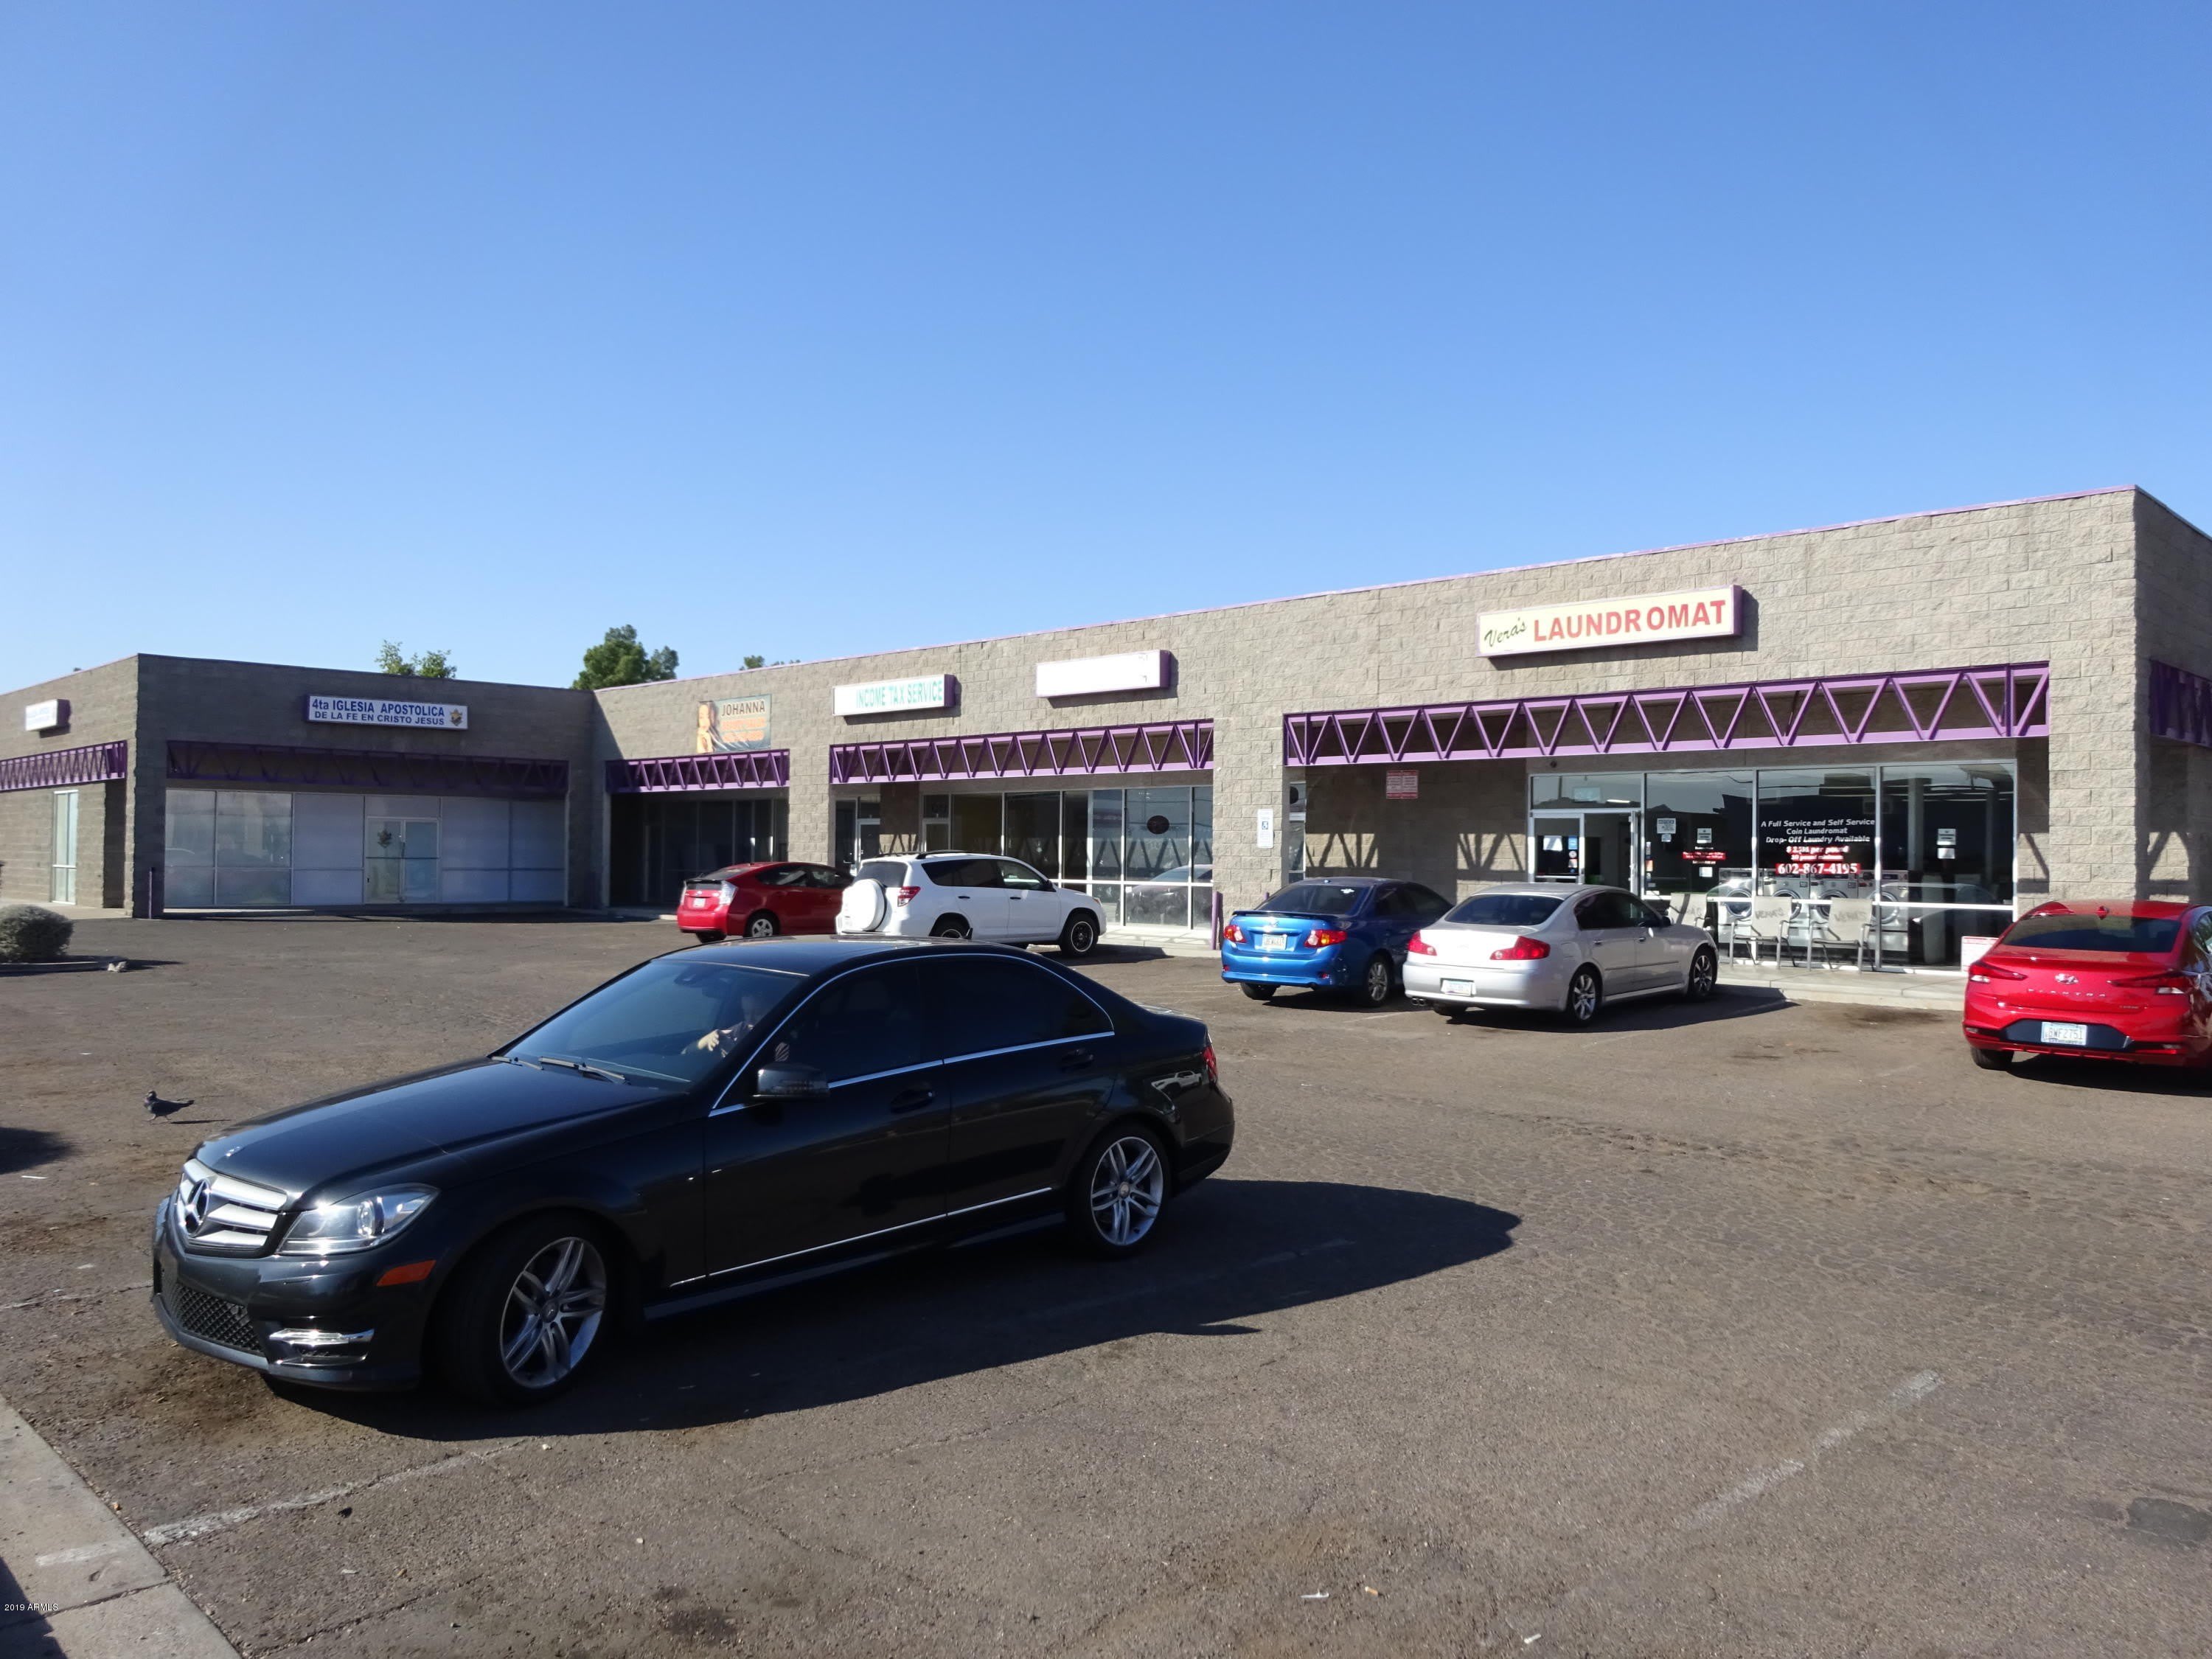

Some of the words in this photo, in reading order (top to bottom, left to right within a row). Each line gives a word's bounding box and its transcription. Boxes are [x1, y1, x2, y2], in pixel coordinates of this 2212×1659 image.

[1484, 616, 1528, 647] Vera's
[1534, 599, 1726, 642] LAUNDROMAT
[856, 686, 886, 708] INCOME
[888, 685, 905, 704] TAX
[907, 680, 943, 703] SERVICE
[312, 698, 329, 710] 4ta
[333, 700, 375, 713] IGLESIA
[380, 703, 445, 717] APOSTOLICA
[721, 700, 765, 717] JOHANNA
[315, 711, 327, 719] DE
[331, 712, 343, 720] LA
[347, 713, 358, 721] FE
[361, 714, 374, 722] EN
[377, 714, 412, 724] CRISTO
[414, 717, 445, 726] JESUS
[1804, 835, 1833, 844] Laundry
[1777, 863, 1858, 874] 602-867-4195
